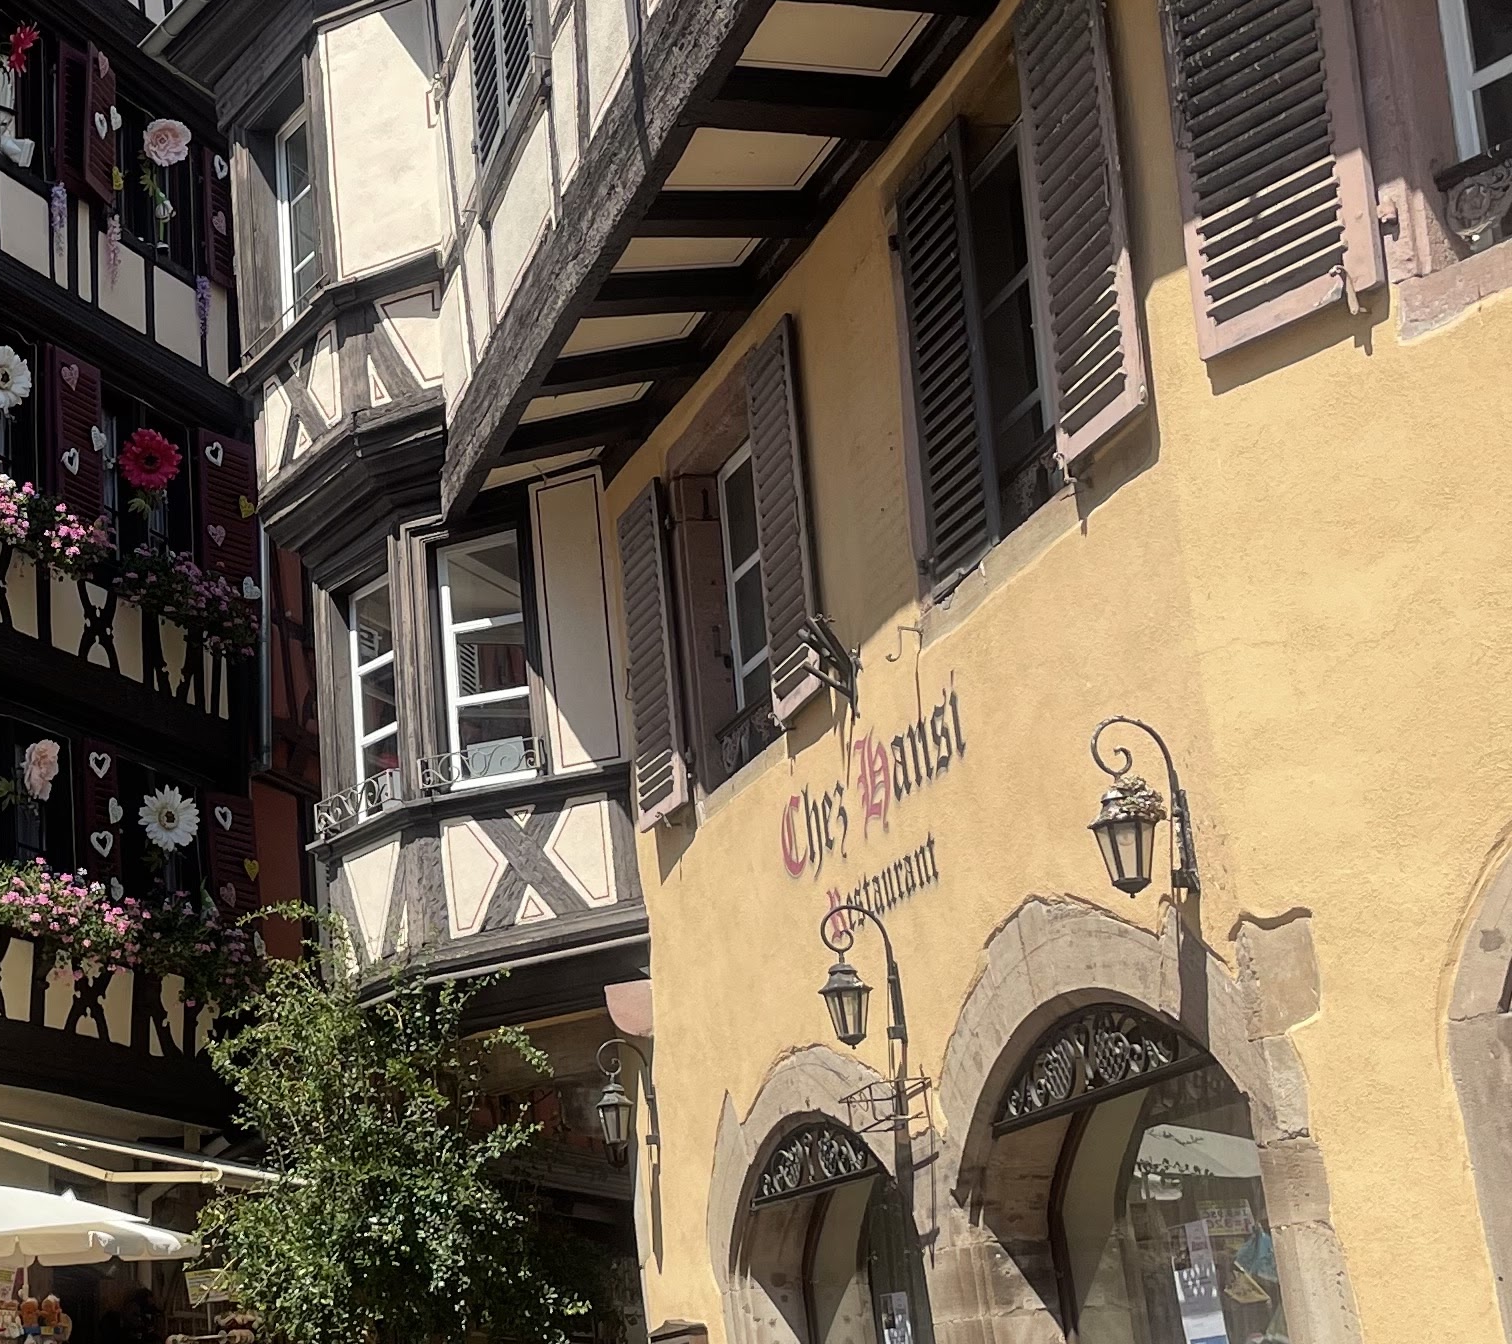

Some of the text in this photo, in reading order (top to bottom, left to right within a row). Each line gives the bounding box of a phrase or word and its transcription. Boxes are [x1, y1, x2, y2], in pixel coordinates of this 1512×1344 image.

[780, 671, 967, 883] Chez Hansi
[825, 830, 939, 945] Restaurant
